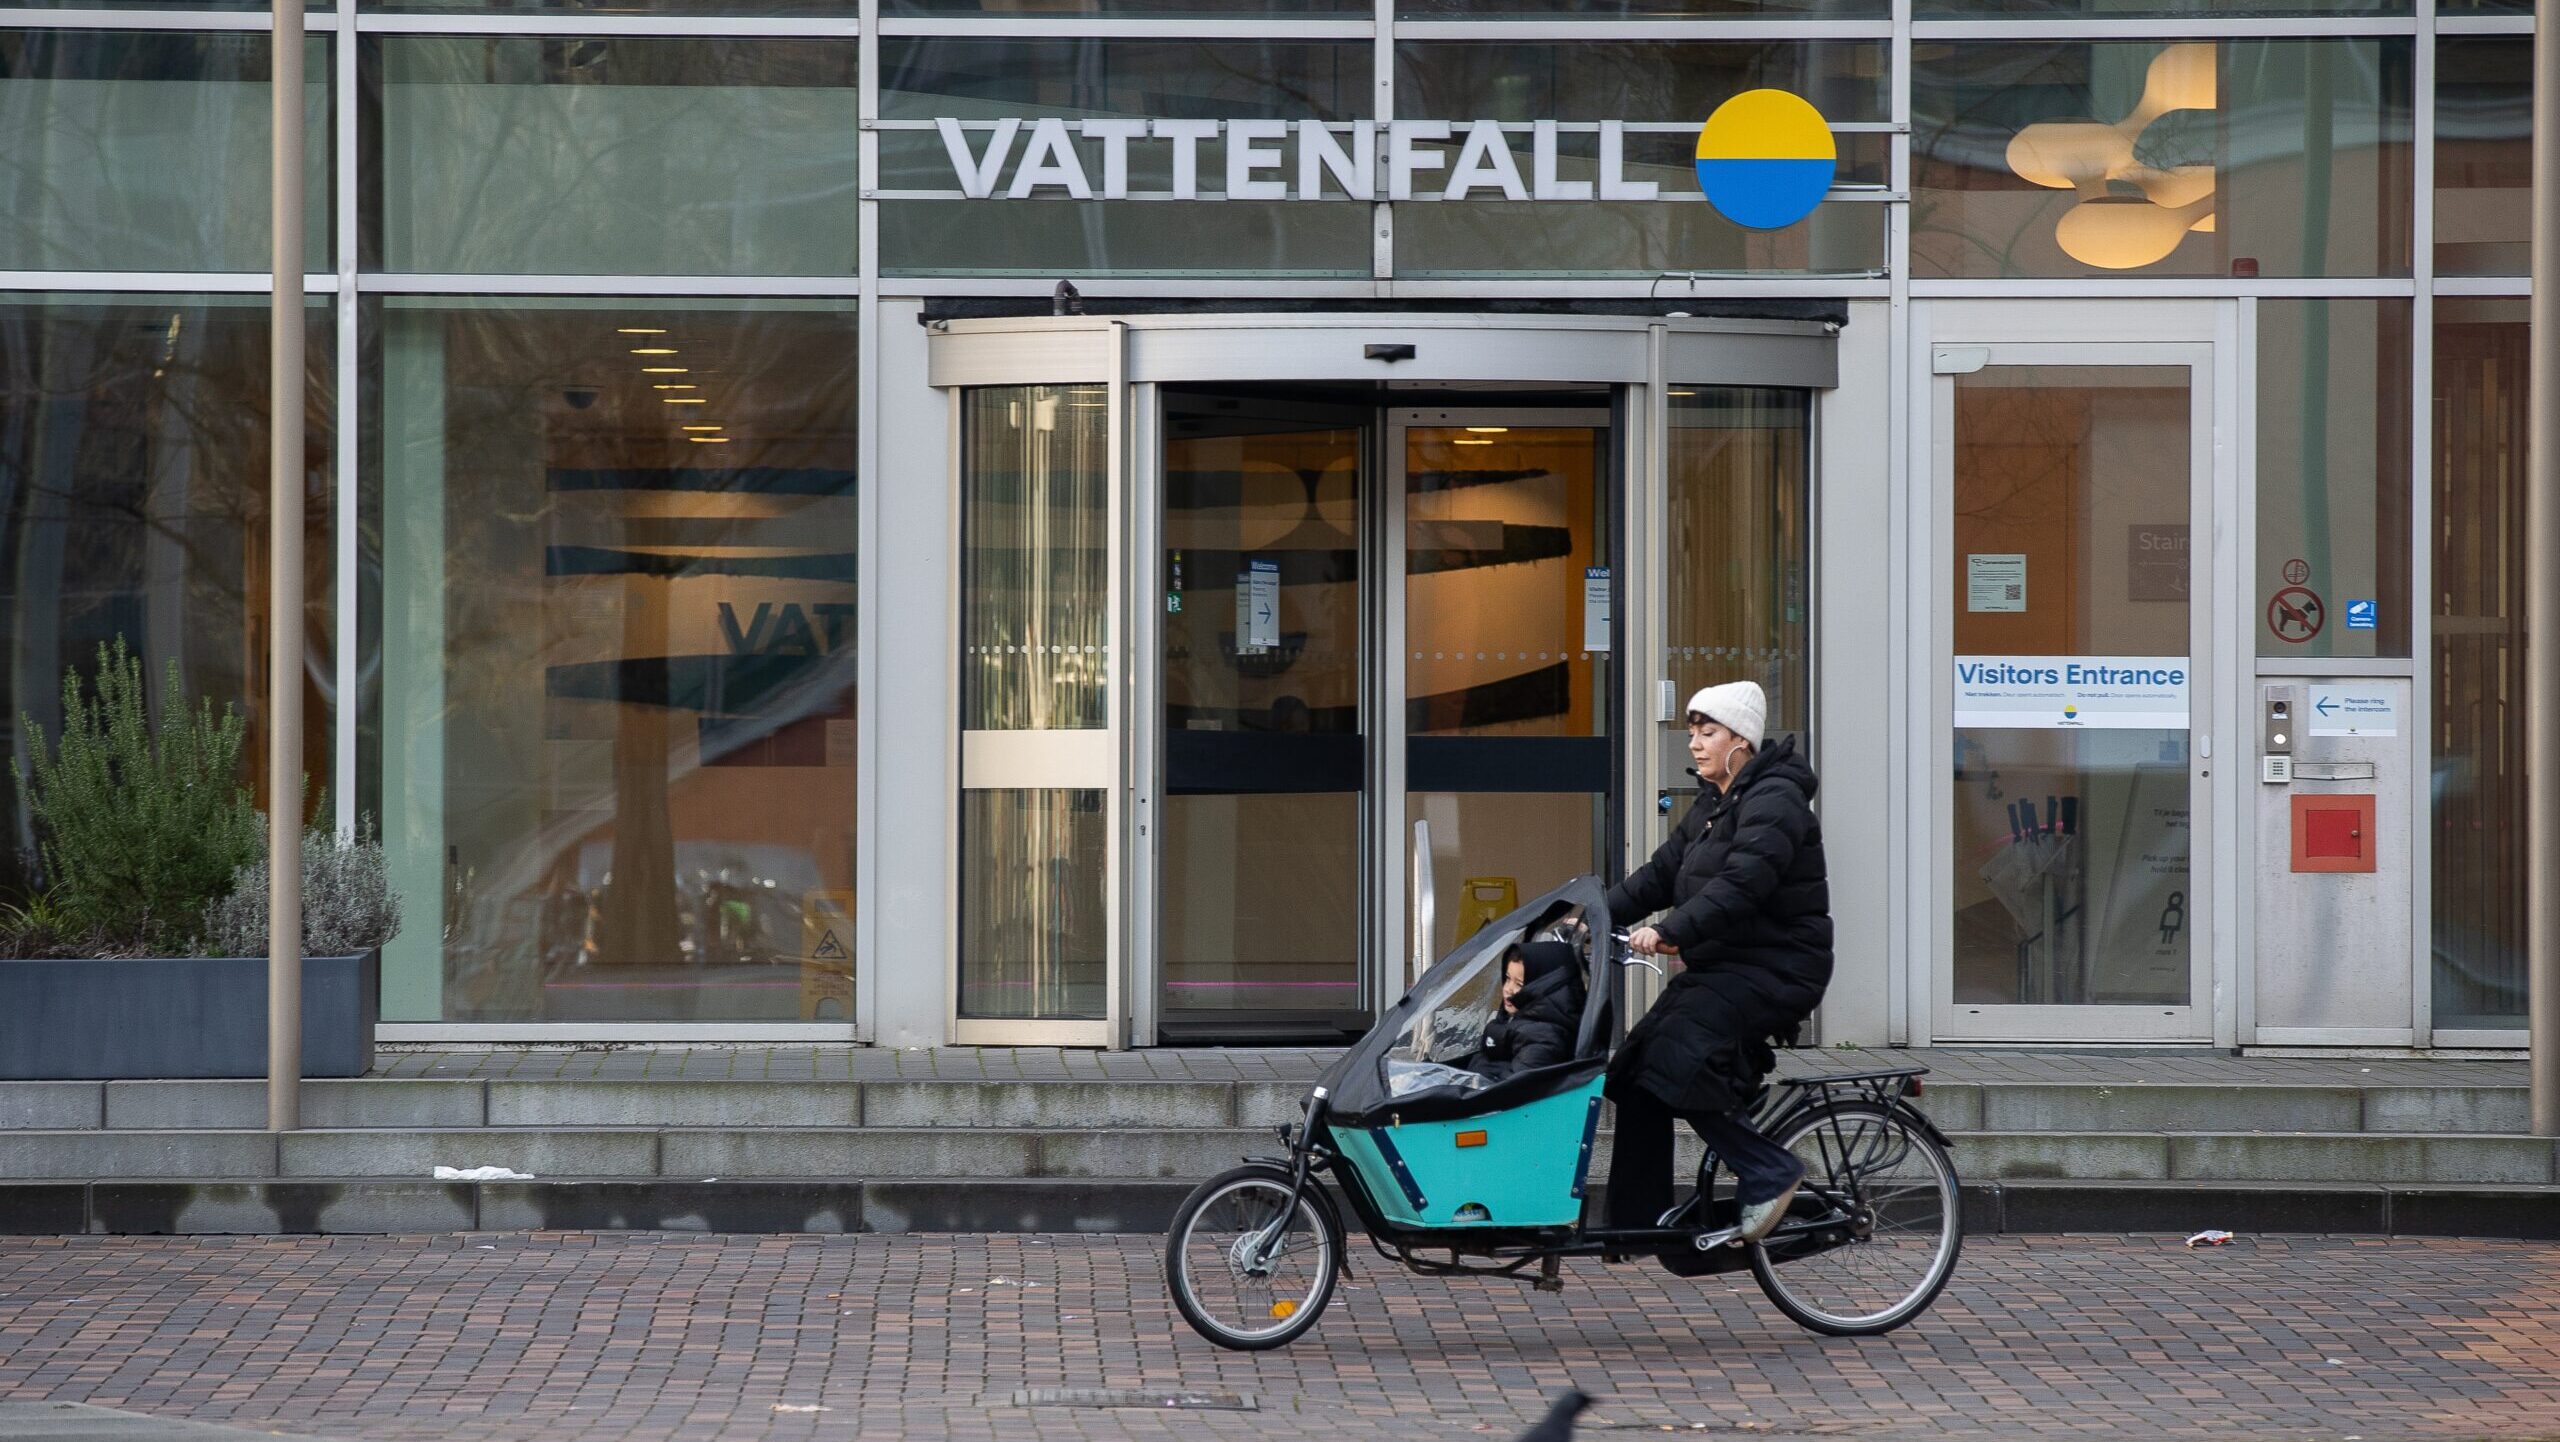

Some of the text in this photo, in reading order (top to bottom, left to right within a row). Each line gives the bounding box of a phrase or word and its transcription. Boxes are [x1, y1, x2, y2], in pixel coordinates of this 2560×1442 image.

[934, 117, 1660, 201] VATTENFALL
[717, 602, 856, 656] VAT
[1957, 663, 2185, 686] Visitors Entrance
